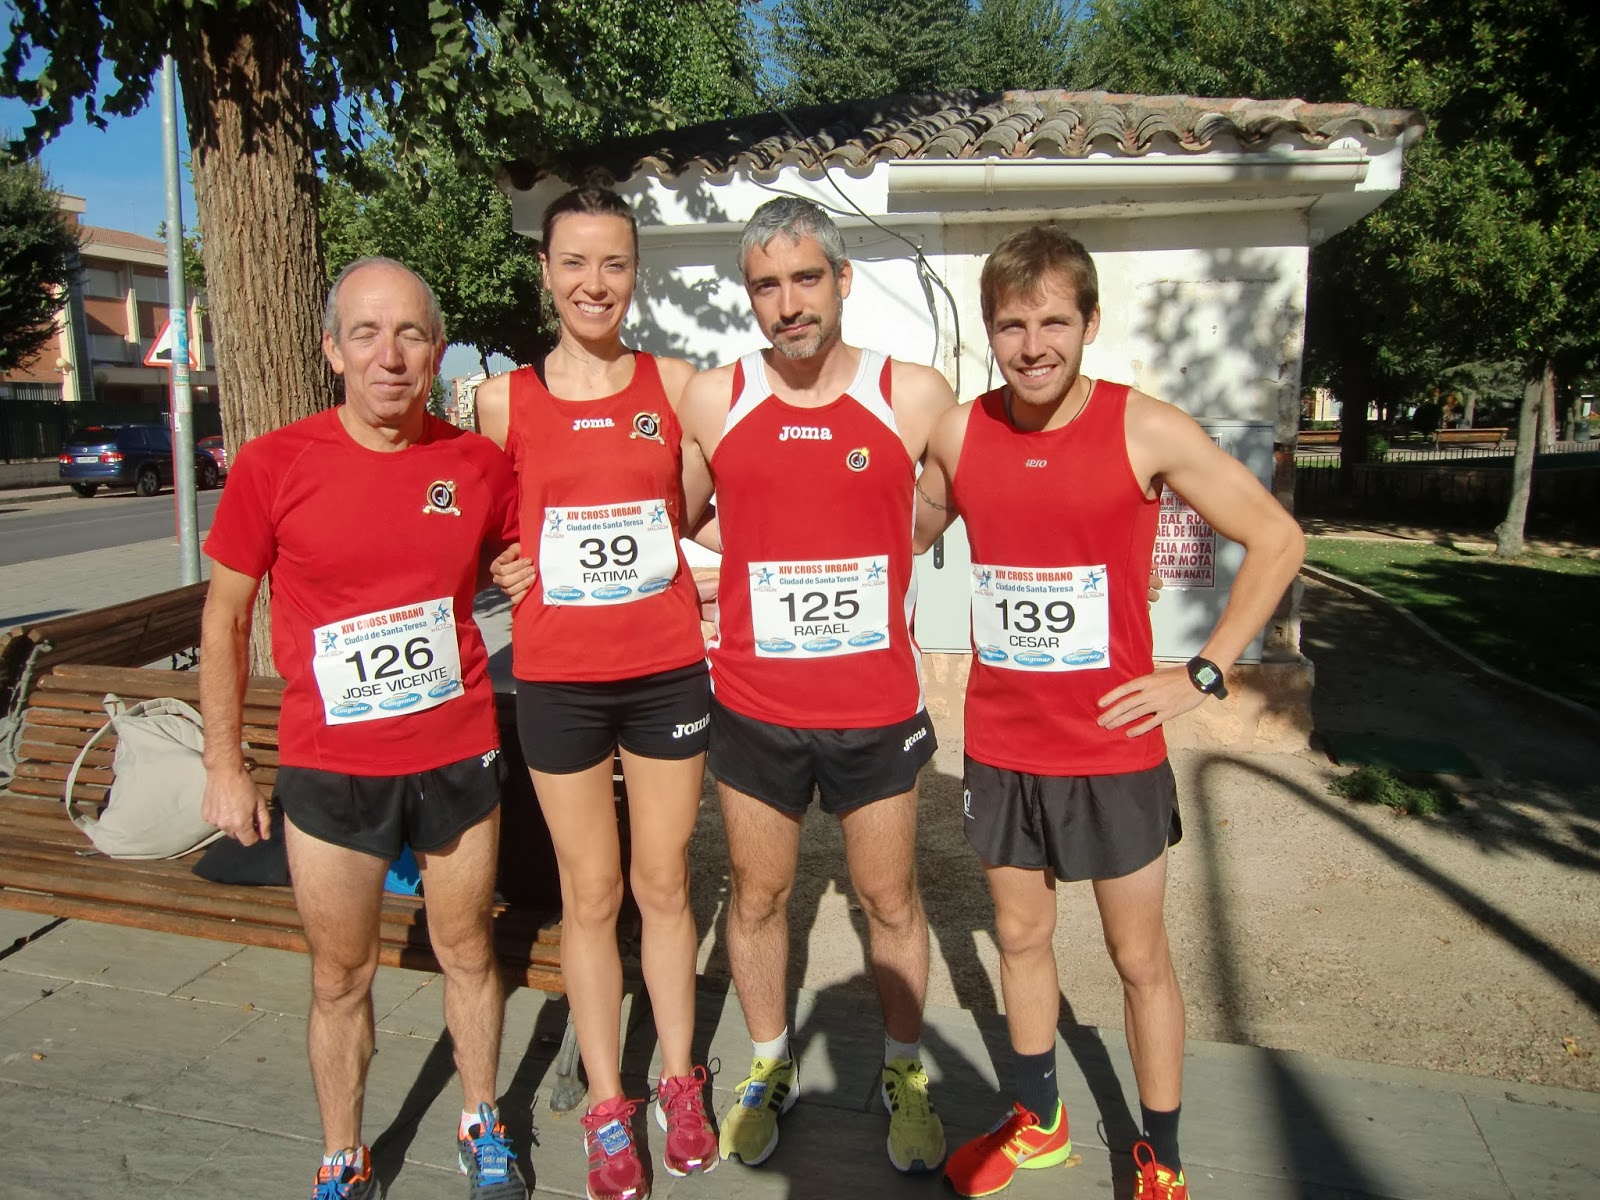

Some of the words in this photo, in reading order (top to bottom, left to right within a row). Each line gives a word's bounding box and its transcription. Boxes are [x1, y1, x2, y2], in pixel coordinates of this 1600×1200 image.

[566, 511, 579, 521] XIV
[581, 509, 610, 520] CROSS
[612, 506, 642, 517] URBANO
[1160, 514, 1182, 524] BAL
[1187, 514, 1206, 525] RU
[566, 522, 591, 531] Ciudad
[592, 522, 602, 530] de
[602, 520, 622, 529] Santa
[1174, 526, 1185, 537] DE
[1188, 526, 1213, 538] JULIA
[579, 535, 638, 569] 39
[1155, 542, 1177, 553] ELIA
[1181, 543, 1212, 553] MOTA
[1154, 555, 1175, 566] CAR
[1179, 555, 1211, 566] MOTA
[779, 566, 792, 575] XIV
[794, 564, 823, 574] CROSS
[825, 562, 859, 573] URBANO
[1184, 569, 1211, 579] ANAYA
[583, 569, 638, 583] FATIMA
[779, 577, 804, 585] Ciudad
[995, 570, 1006, 580] XIV
[1008, 571, 1034, 582] CROSS
[1036, 571, 1073, 581] URBANO
[995, 582, 1016, 592] Ciudad
[1017, 584, 1025, 592] de
[779, 589, 860, 622] 125
[341, 622, 355, 635] XIV
[357, 615, 387, 631] CROSS
[390, 607, 424, 624] URBANO
[995, 599, 1075, 633] 139
[344, 631, 369, 646] Ciudad
[370, 630, 380, 639] de
[381, 626, 404, 638] Santa
[405, 620, 427, 631] Teresa
[794, 623, 850, 636] RAFAEL
[1009, 635, 1059, 648] CESAR
[346, 636, 434, 683] 126
[343, 684, 382, 700] JOSE
[386, 666, 447, 692] VICENTE
